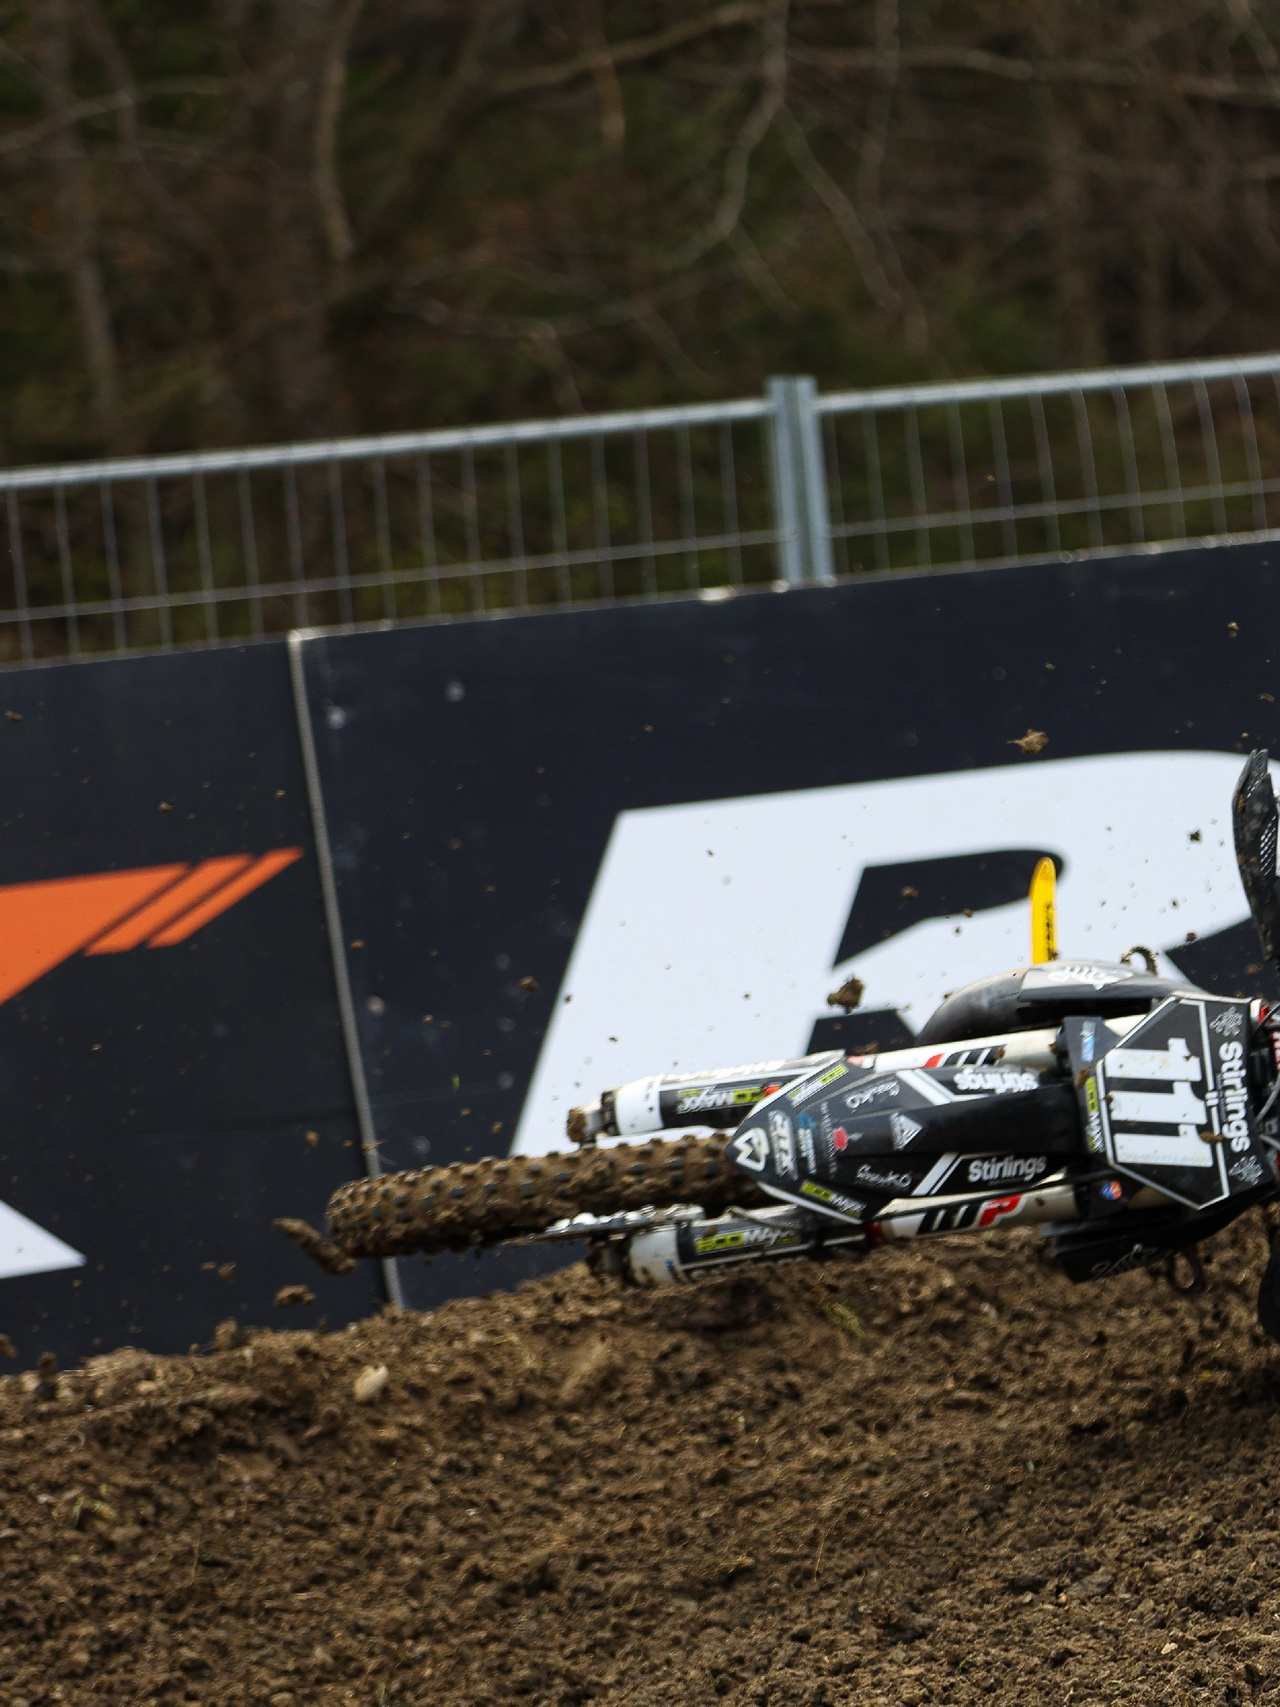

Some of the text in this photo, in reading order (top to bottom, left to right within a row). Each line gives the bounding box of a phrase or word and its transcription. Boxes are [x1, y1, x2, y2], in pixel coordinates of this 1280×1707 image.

[1104, 1037, 1214, 1168] 111
[1219, 1040, 1251, 1154] Stirlings
[968, 1155, 1047, 1183] Stirlings
